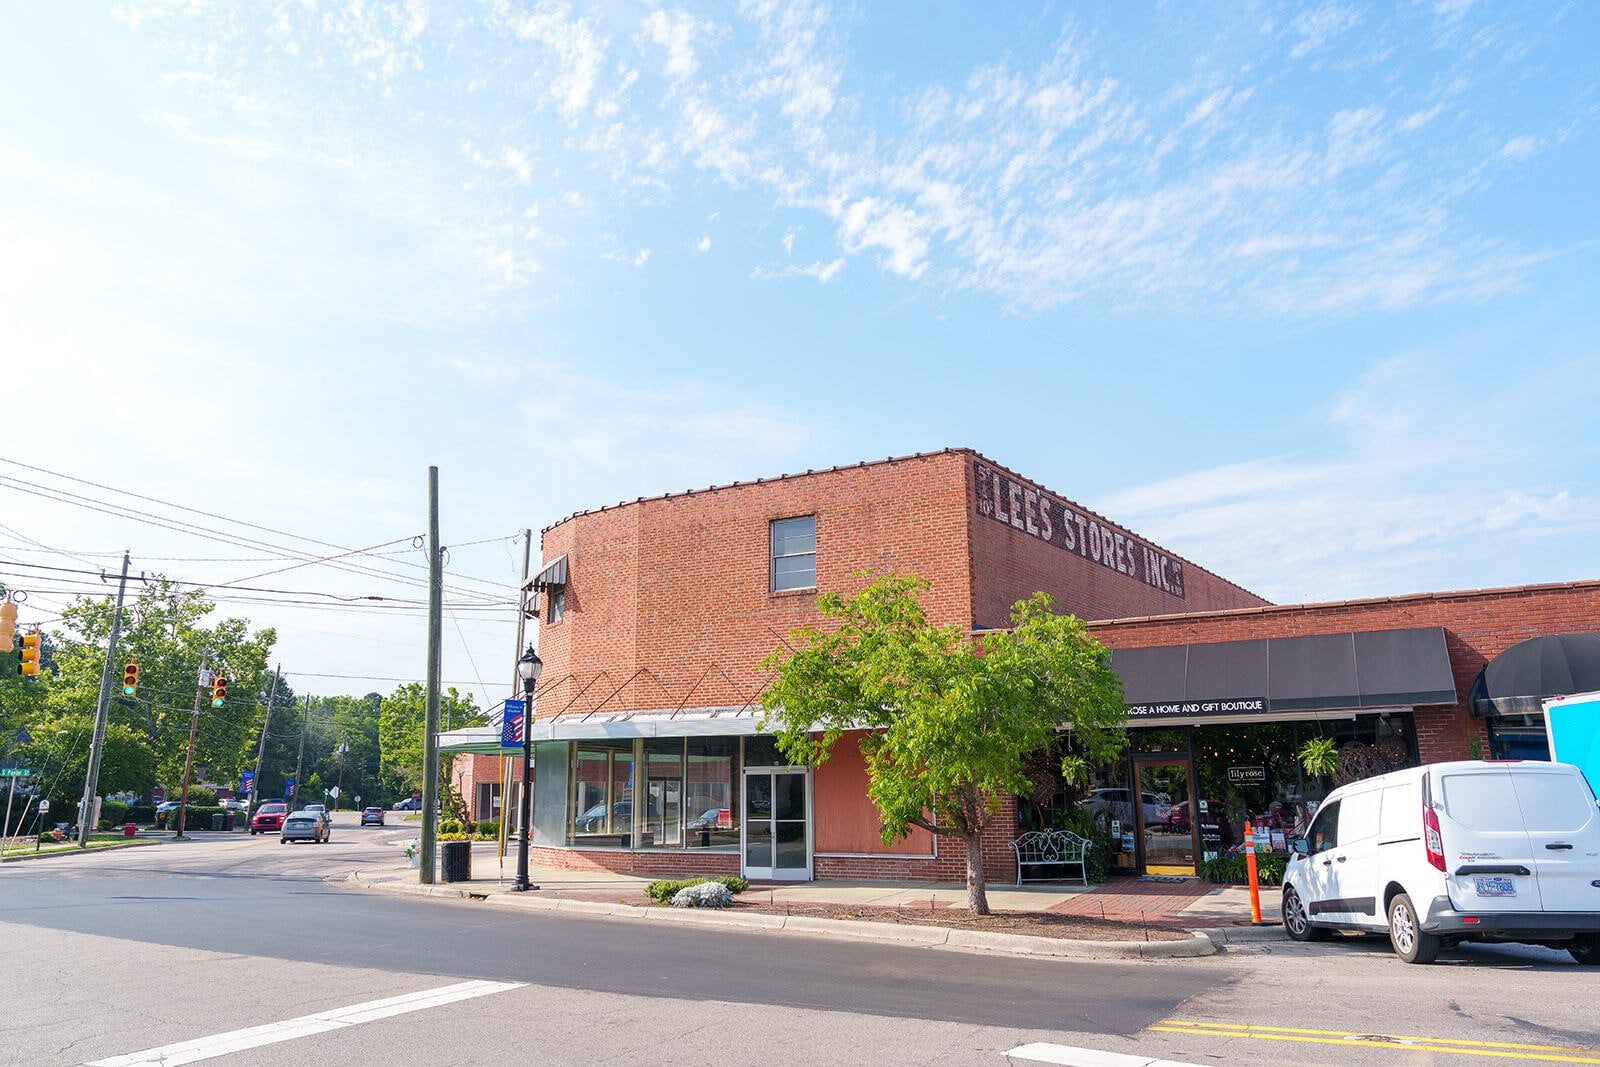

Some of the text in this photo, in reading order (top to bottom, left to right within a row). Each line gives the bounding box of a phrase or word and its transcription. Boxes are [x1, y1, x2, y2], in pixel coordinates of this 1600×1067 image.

[993, 473, 1053, 541] LEE'S
[1063, 509, 1135, 576] STORES
[1127, 706, 1147, 715] ROSE
[1149, 706, 1155, 714] A
[1156, 704, 1180, 714] HOME
[1182, 703, 1200, 712] AND
[1201, 702, 1219, 712] GIFT
[1221, 700, 1262, 711] BOUTIQUE
[1231, 770, 1244, 779] lily
